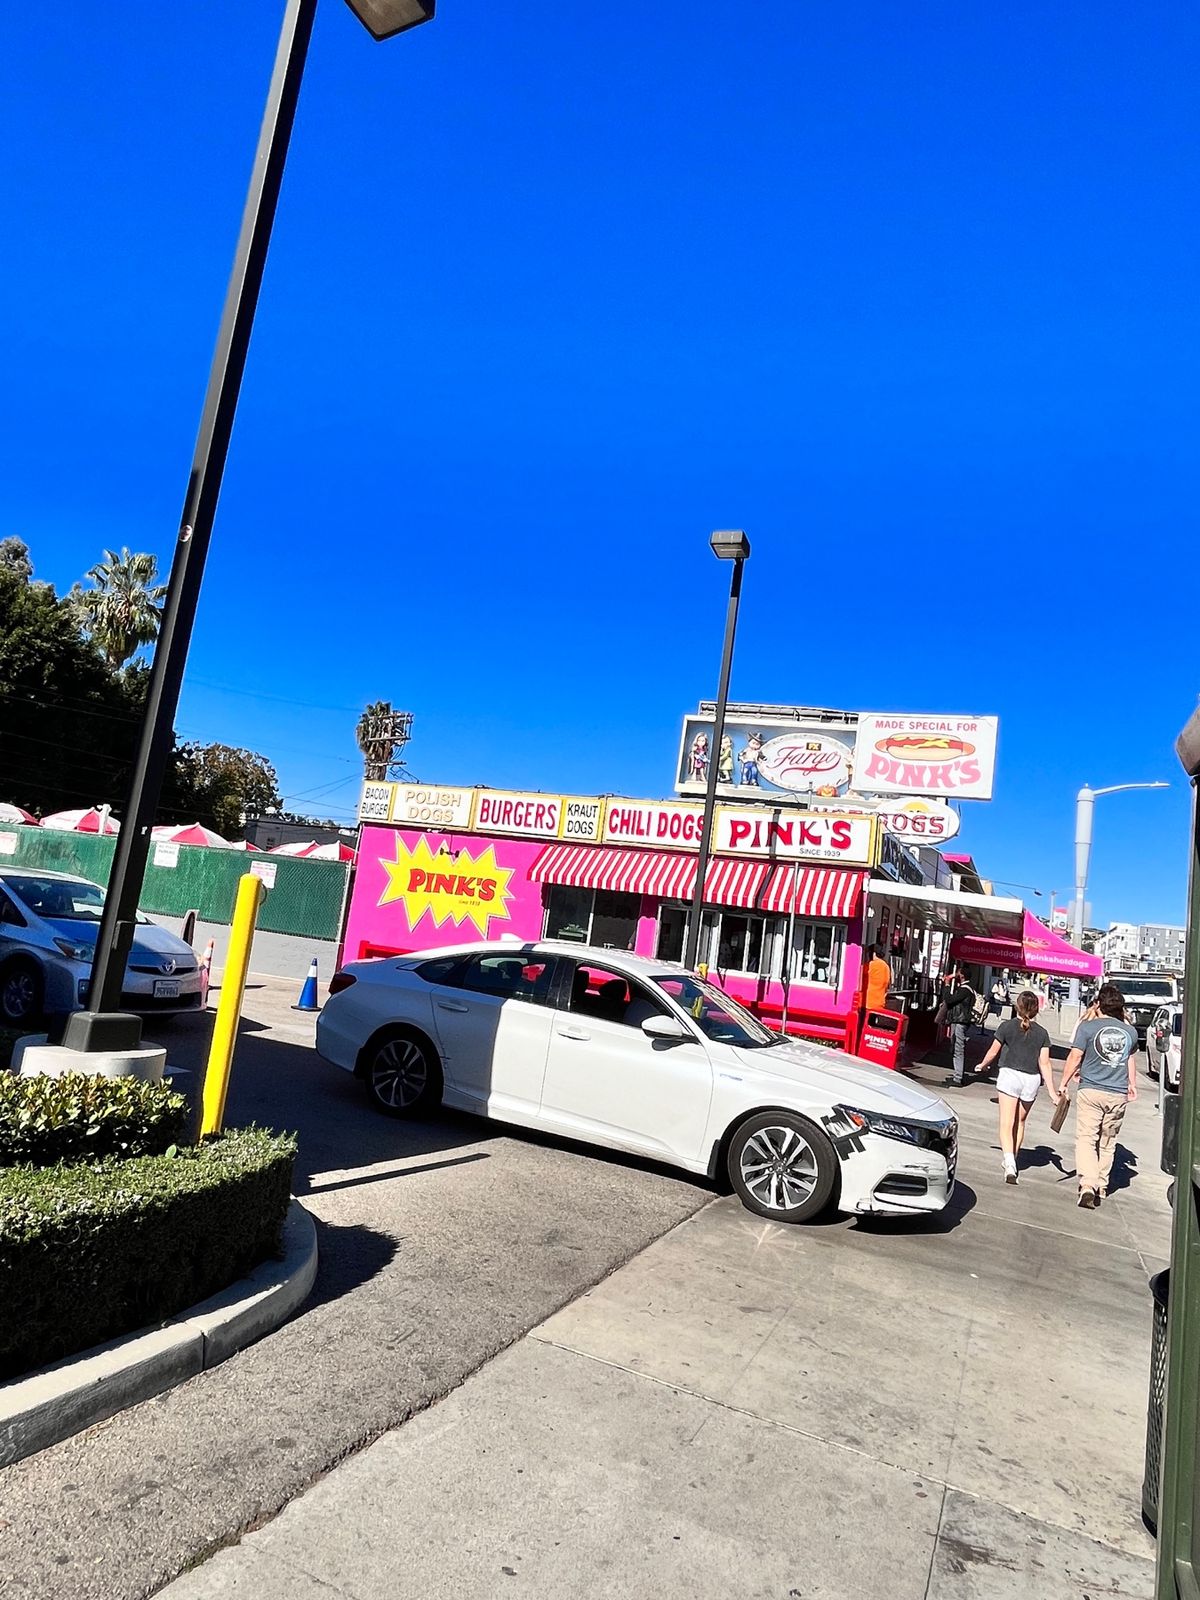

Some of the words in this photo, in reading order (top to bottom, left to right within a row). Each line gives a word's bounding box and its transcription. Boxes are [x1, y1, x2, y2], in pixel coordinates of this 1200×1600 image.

[876, 719, 906, 731] MADE
[908, 721, 954, 732] SPECIAL
[957, 722, 978, 732] FOR
[767, 746, 841, 779] Fargo
[865, 753, 980, 787] PINK'S
[365, 787, 389, 800] BACON
[405, 789, 461, 807] POLISH
[361, 802, 388, 815] BURGER
[407, 806, 454, 823] DOGS
[480, 797, 557, 830] BURGERS
[567, 803, 598, 818] KRAUT
[567, 820, 595, 835] DOGS
[608, 808, 652, 838] CHILI
[729, 819, 852, 850] PINK'S
[799, 847, 821, 856] SINCE
[407, 868, 497, 901] PINK'S
[1025, 952, 1089, 969] #pinkshotdogs
